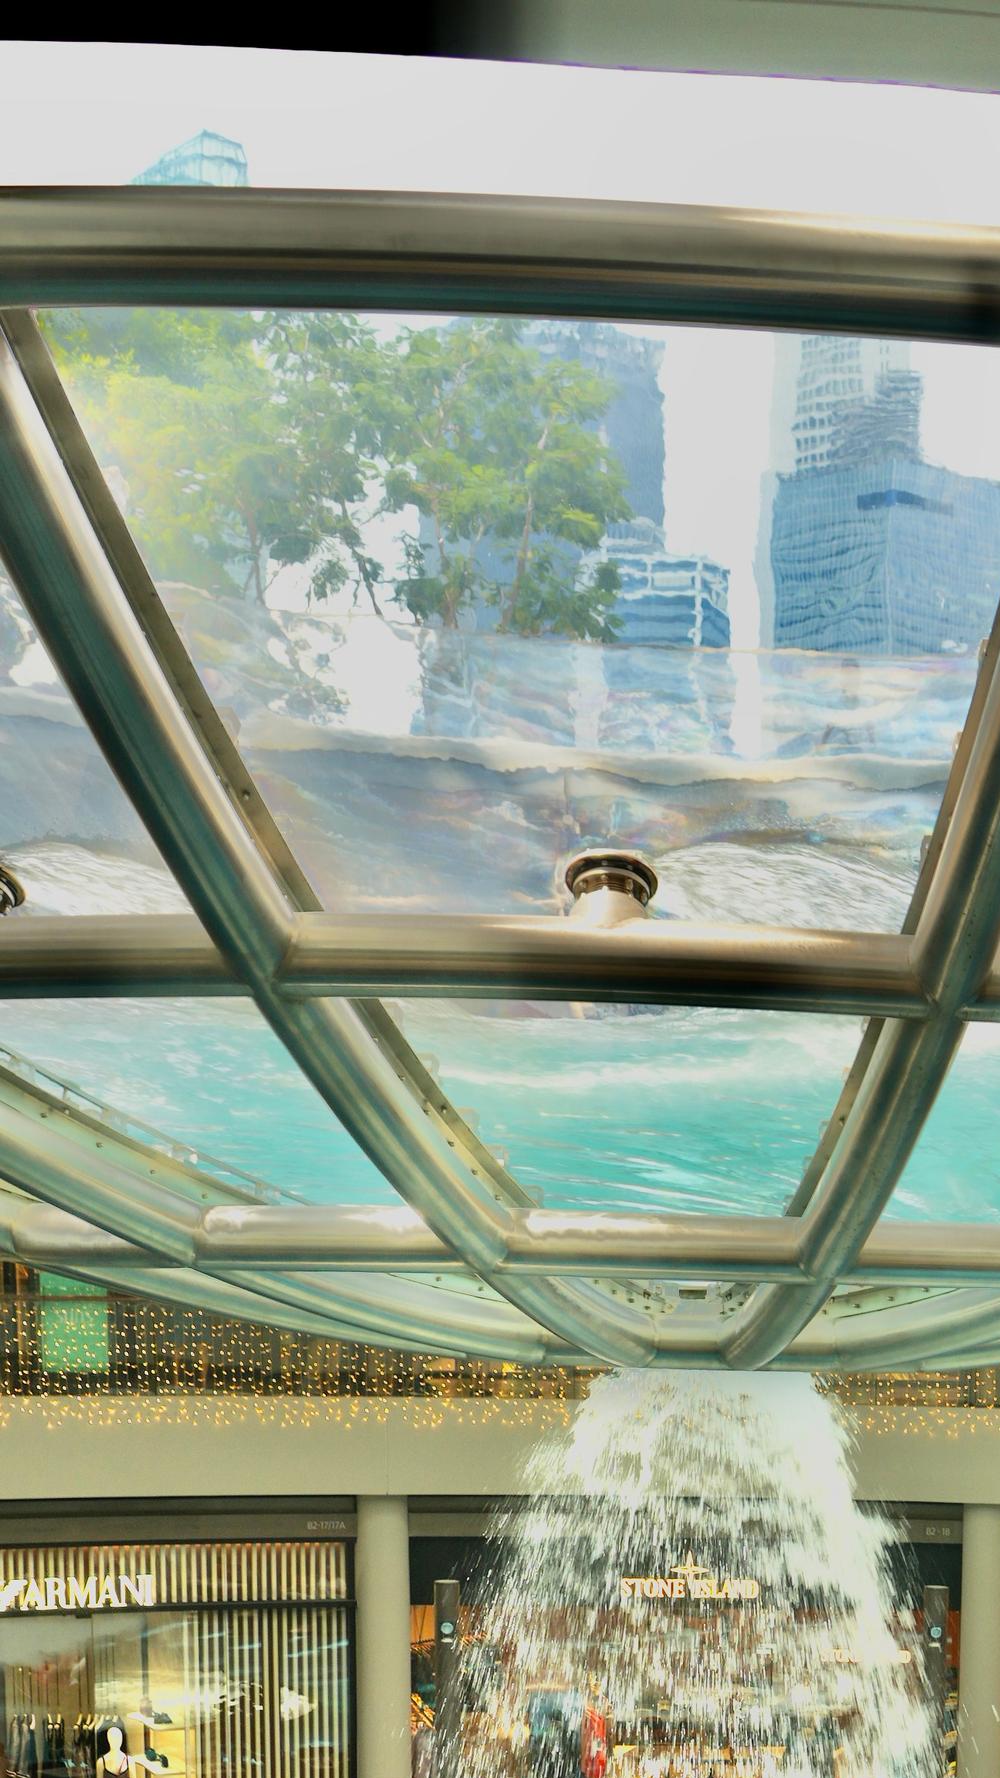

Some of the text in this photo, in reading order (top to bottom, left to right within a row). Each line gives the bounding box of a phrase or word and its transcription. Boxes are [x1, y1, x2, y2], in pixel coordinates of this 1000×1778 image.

[20, 1573, 154, 1611] ARMANI
[620, 1578, 760, 1599] STONE ISLAND
